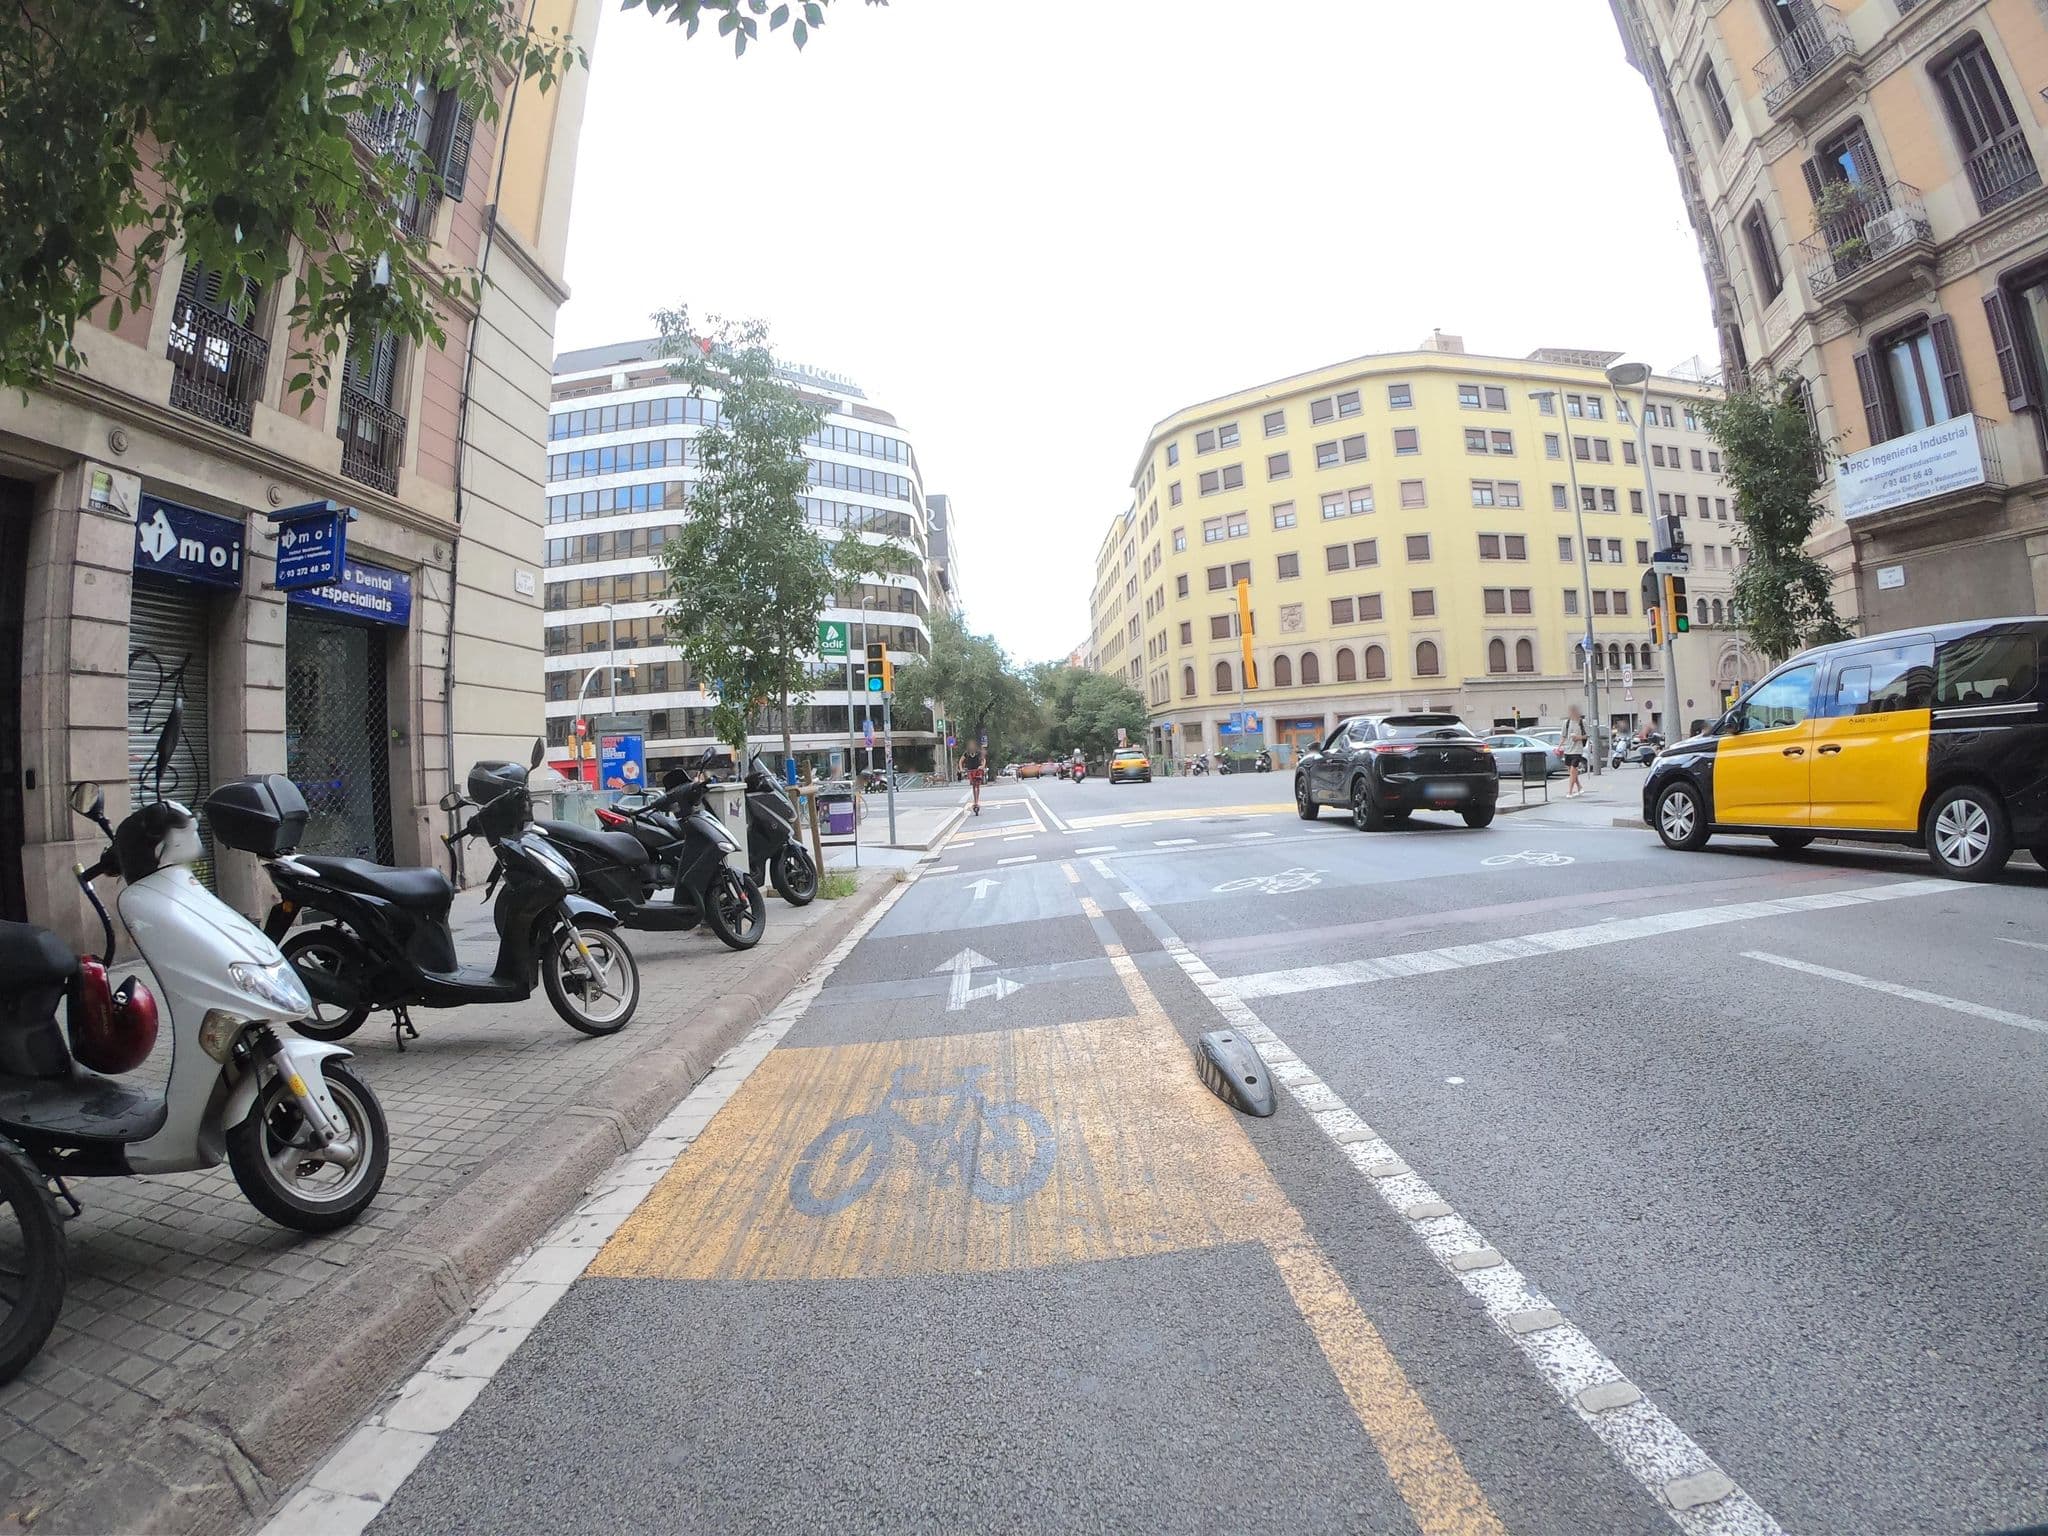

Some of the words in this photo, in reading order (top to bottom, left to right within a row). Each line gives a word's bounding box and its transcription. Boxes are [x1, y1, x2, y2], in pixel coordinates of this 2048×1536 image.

[1850, 459, 1870, 473] PRC
[1920, 425, 1968, 450] Industrial
[1889, 478, 1898, 488] 93
[1899, 475, 1911, 486] 487
[1924, 467, 1933, 477] 49
[286, 569, 295, 578] 93
[297, 567, 308, 577] 272
[310, 565, 319, 574] 48
[321, 563, 331, 572] 30
[355, 569, 392, 592] Dental
[821, 640, 845, 649] adif
